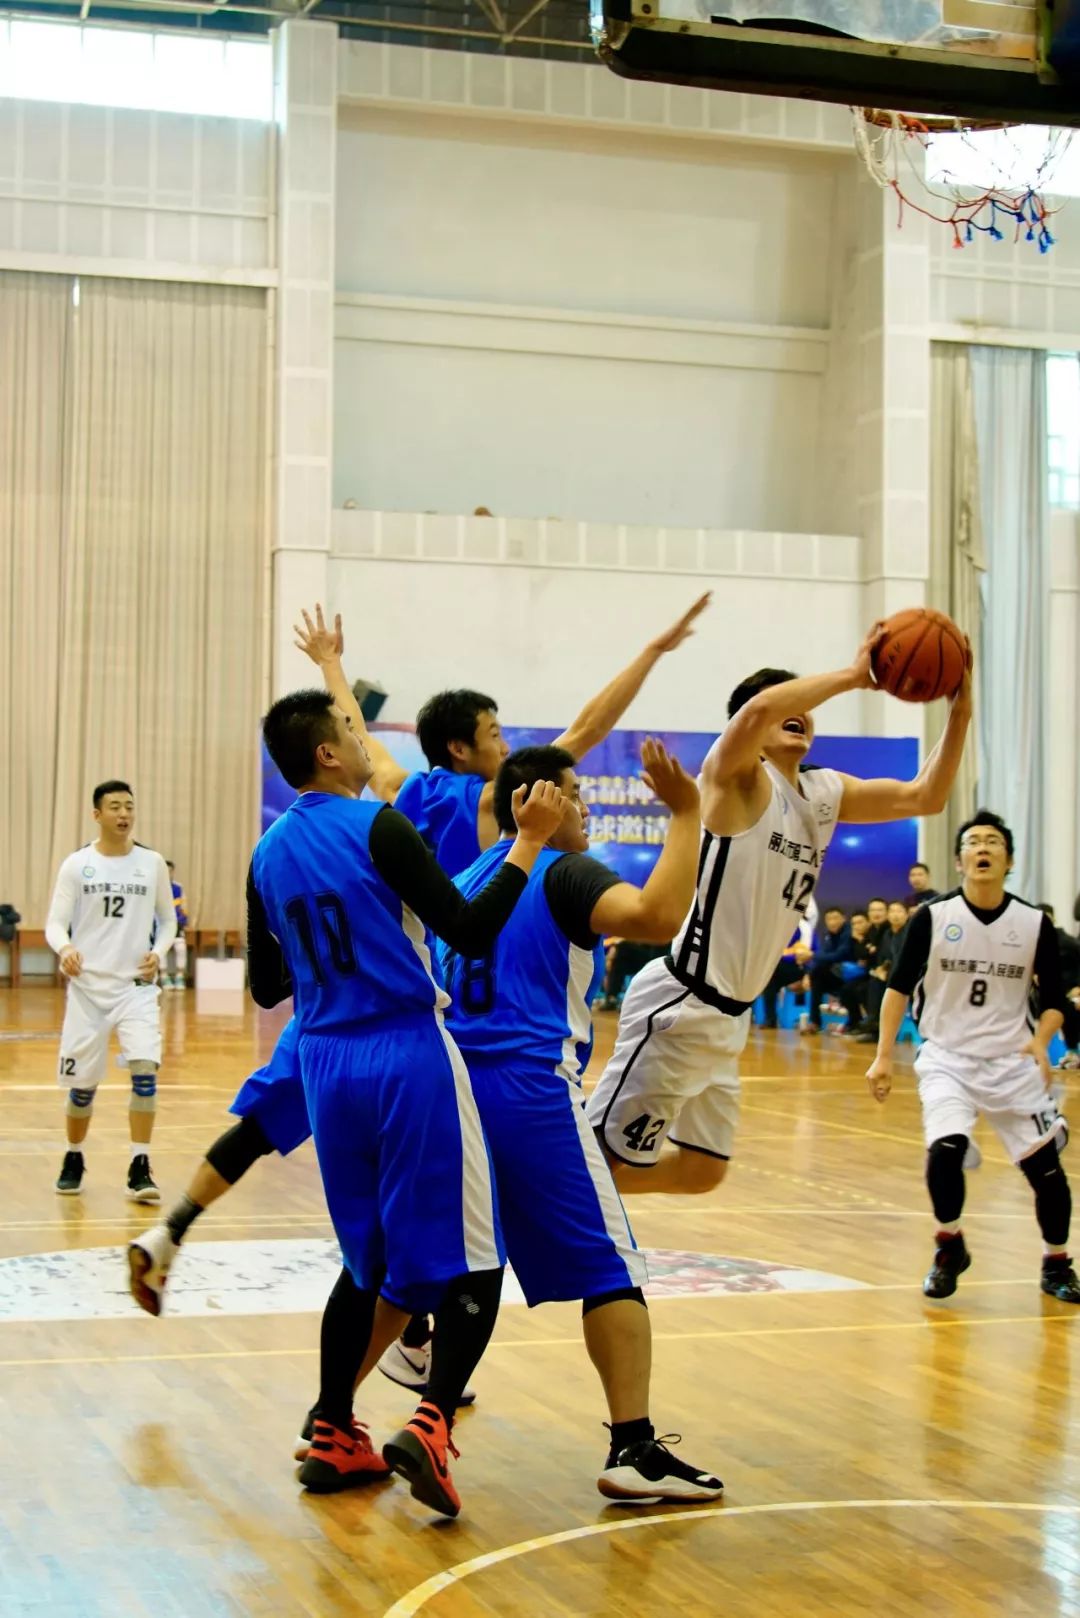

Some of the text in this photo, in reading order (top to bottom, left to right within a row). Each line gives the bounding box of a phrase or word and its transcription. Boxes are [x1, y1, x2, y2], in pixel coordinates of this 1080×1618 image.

[103, 896, 125, 918] 12
[782, 869, 815, 913] 42
[284, 890, 357, 987] 10
[969, 979, 988, 1007] 8
[60, 1056, 76, 1076] 12
[623, 1113, 665, 1152] 42
